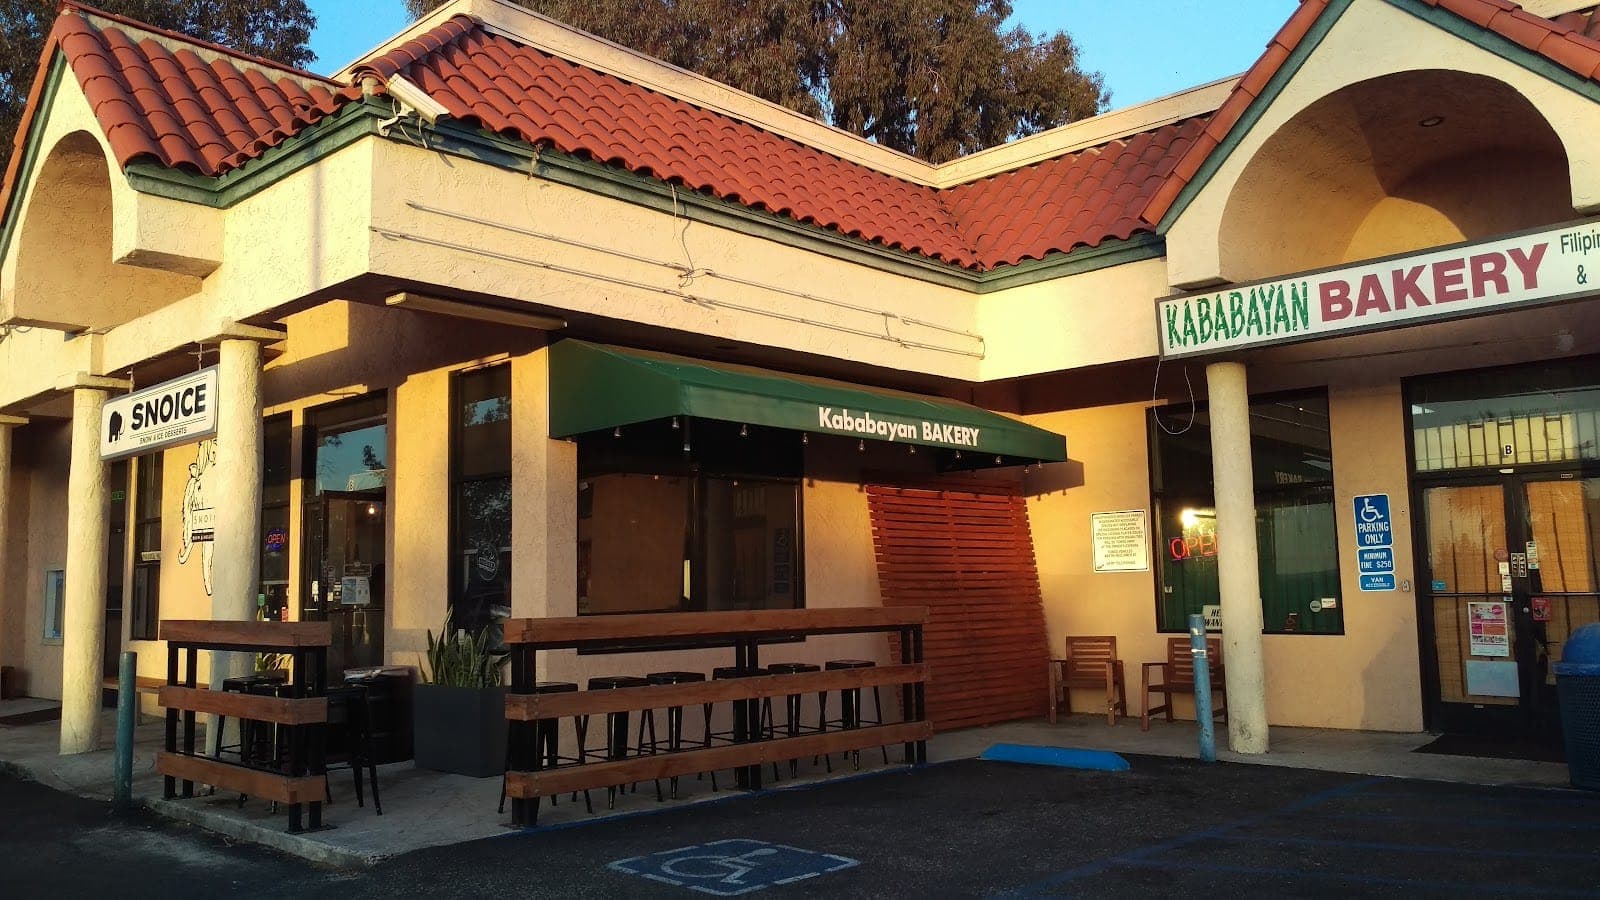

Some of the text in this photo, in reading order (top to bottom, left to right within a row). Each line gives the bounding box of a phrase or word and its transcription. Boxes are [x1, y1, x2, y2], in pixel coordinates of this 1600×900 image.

[1576, 264, 1588, 285] &
[1165, 242, 1549, 349] KABABAYAN BAKERY
[131, 383, 207, 431] SNOICE
[818, 406, 980, 447] Kababayan BAKERY
[1358, 521, 1389, 533] PARKING
[268, 533, 287, 545] OPEN
[1364, 534, 1384, 544] ONLY
[1363, 552, 1387, 560] MINIMUM
[1376, 560, 1392, 569] $250
